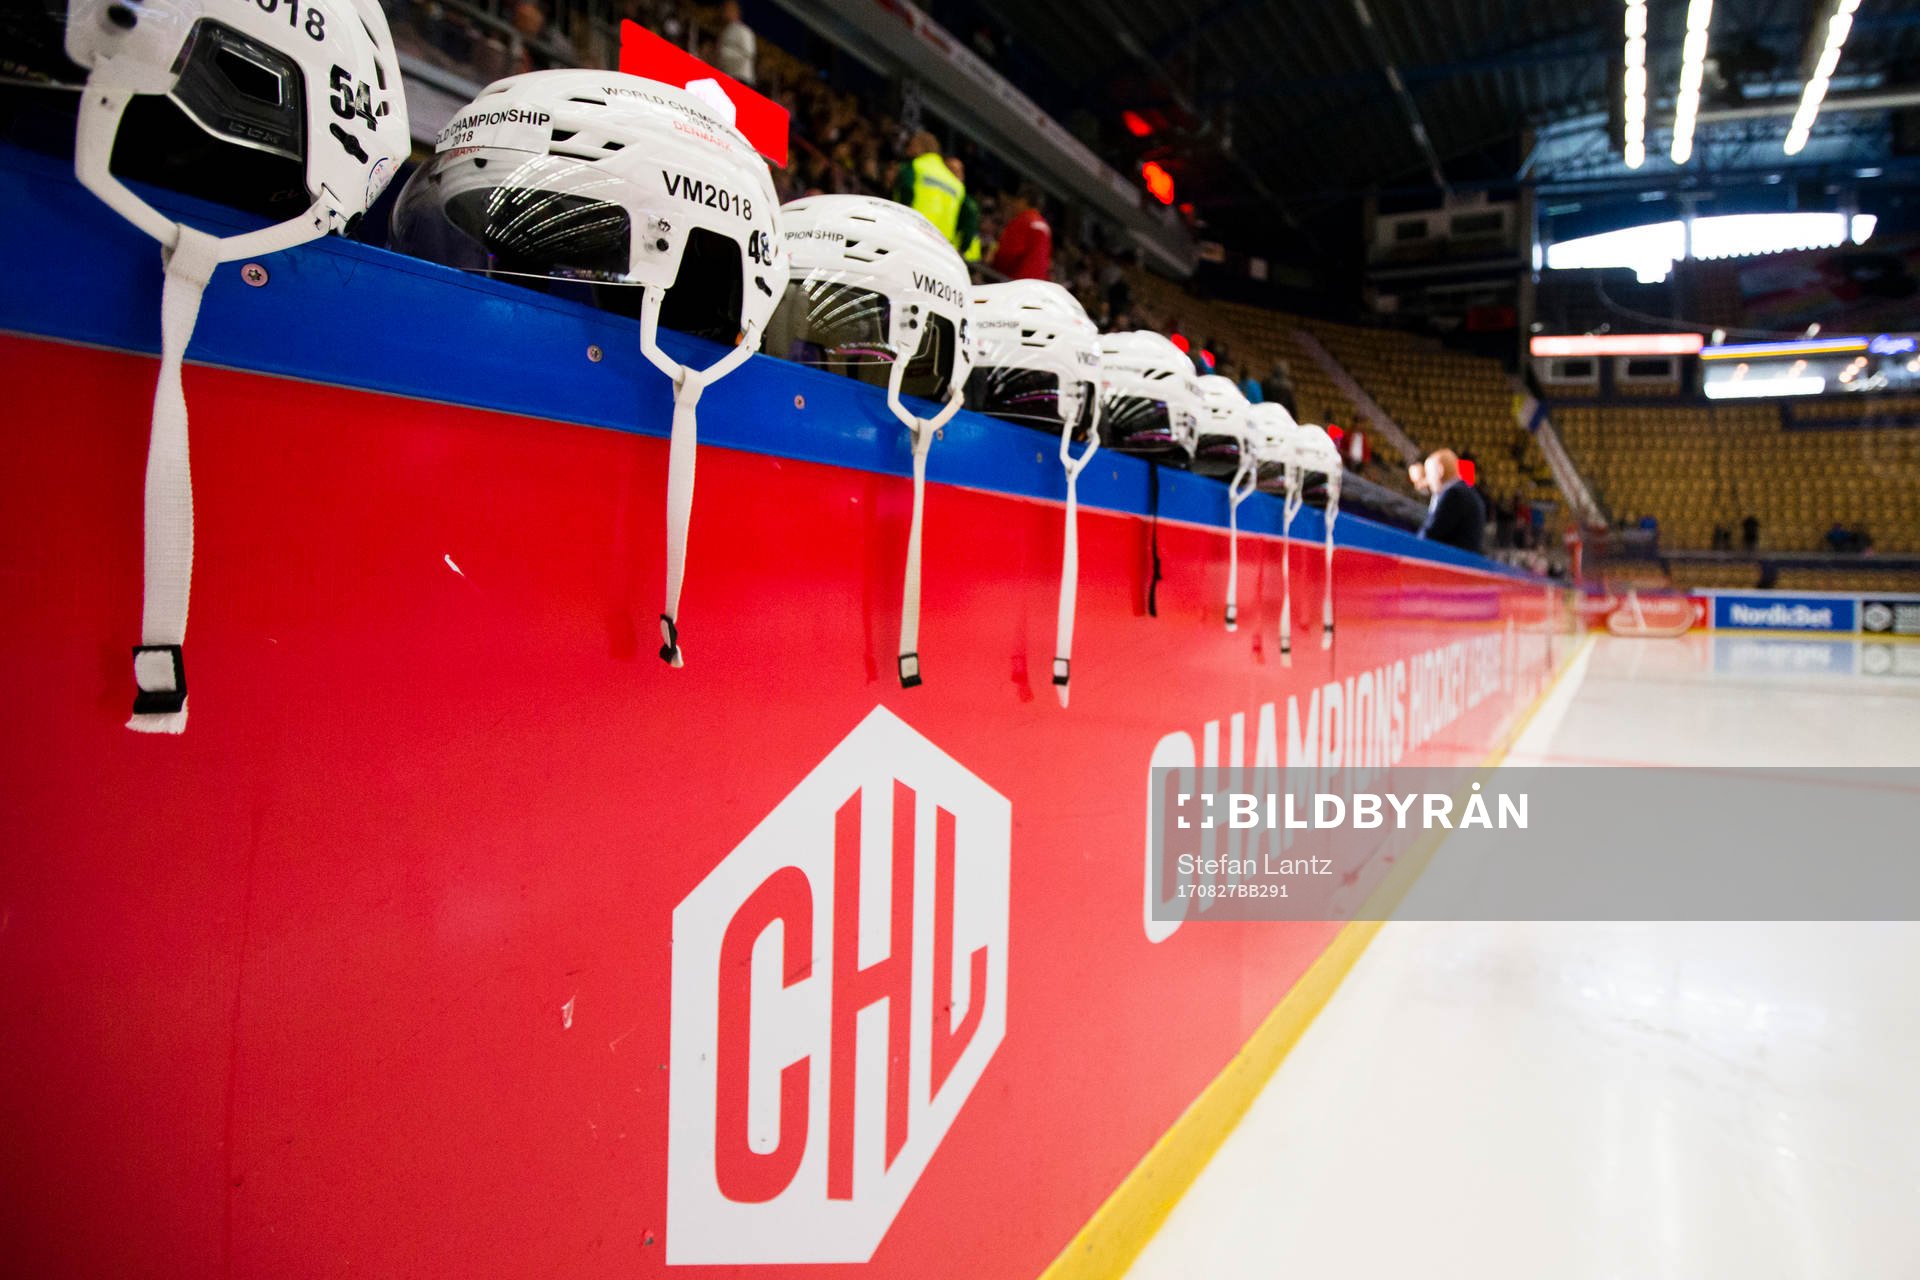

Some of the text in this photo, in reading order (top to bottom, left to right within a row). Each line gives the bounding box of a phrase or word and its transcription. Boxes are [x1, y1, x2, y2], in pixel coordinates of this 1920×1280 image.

[330, 64, 378, 132] 54
[602, 87, 665, 105] WORLD
[450, 109, 550, 136] CHAMPIONSHIP
[452, 131, 474, 147] 2018
[662, 170, 752, 221] VM2018
[748, 230, 772, 266] 48
[913, 271, 963, 308] VM2018
[1729, 602, 1833, 626] NordicBet
[1142, 660, 1406, 944] CHAMPIONS
[714, 775, 989, 1205] CHL
